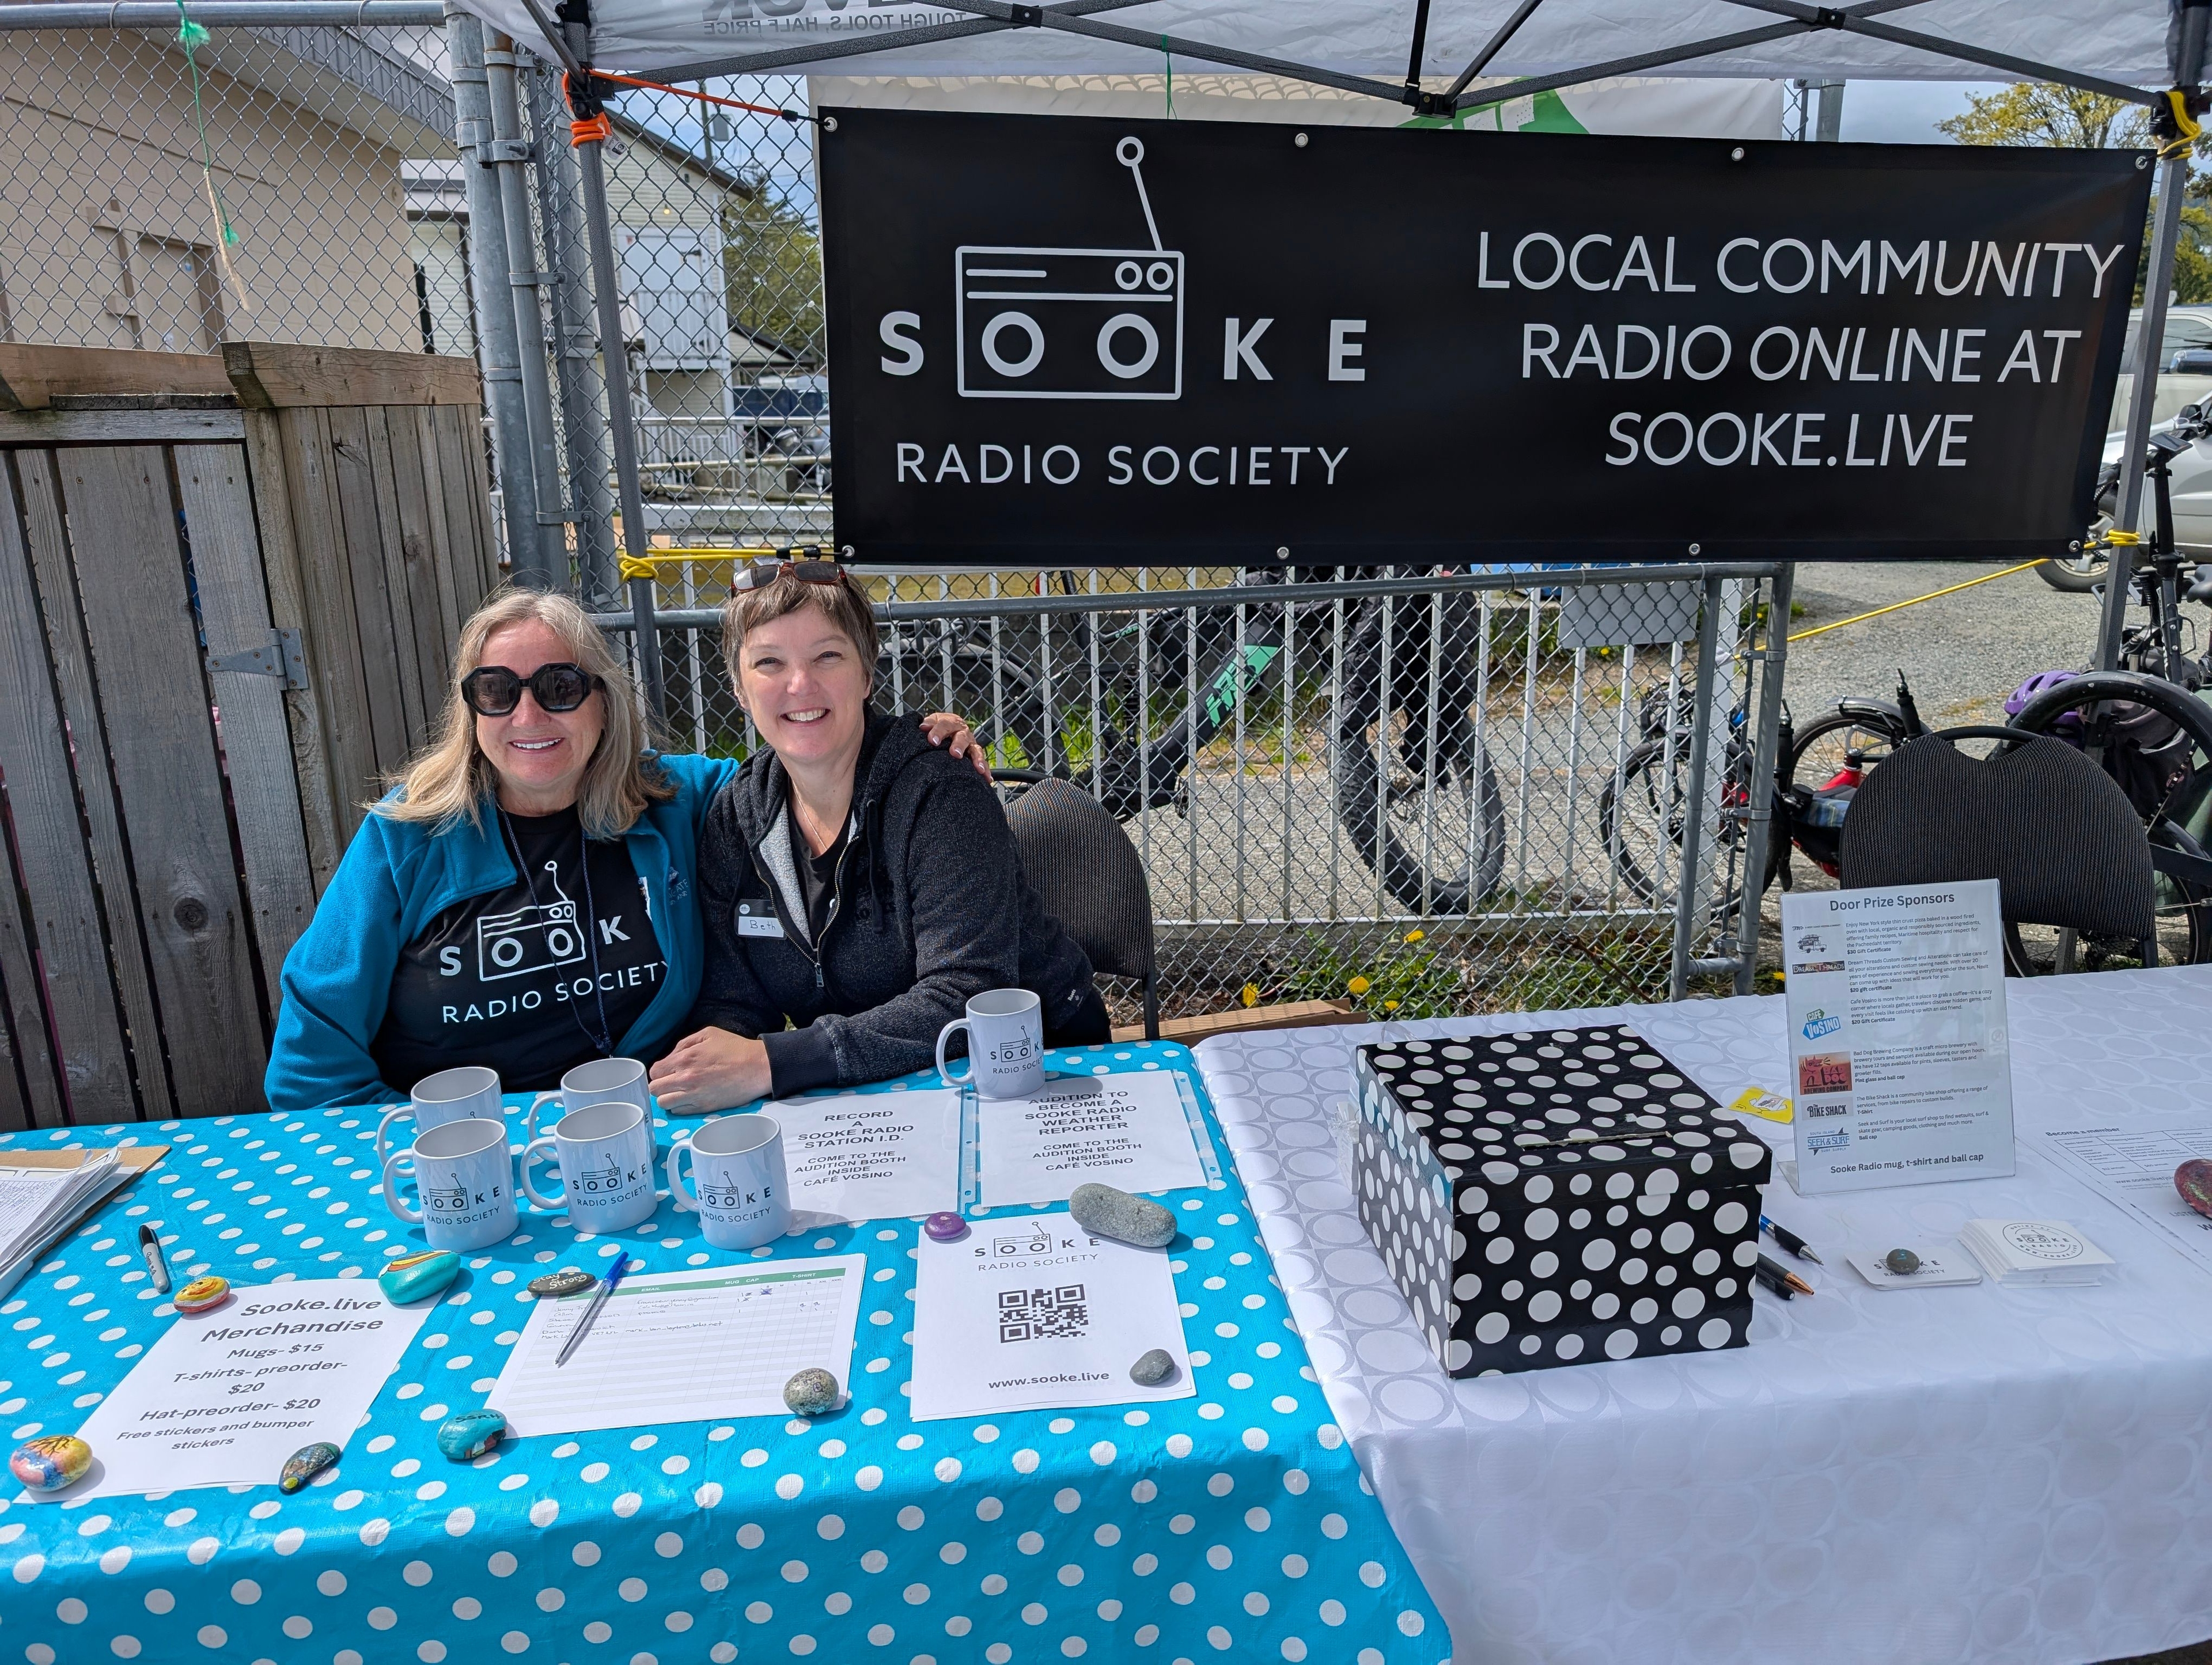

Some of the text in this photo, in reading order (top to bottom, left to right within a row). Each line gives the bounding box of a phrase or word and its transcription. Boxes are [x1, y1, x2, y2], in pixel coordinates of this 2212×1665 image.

[1478, 231, 2124, 298] LOCAL COMMUNITY
[1522, 324, 2081, 383] RADIO ONLINE AT
[1605, 412, 1974, 467] SOOKE.LIVE
[897, 443, 1349, 485] RADIO SOCIETY
[1830, 893, 1955, 911] Door Prize Sponsors
[749, 920, 776, 931] Beth
[440, 915, 631, 976] SOOK
[1067, 989, 1076, 1001] Roots
[442, 991, 541, 1023] RADIO
[1808, 1010, 1821, 1021] CAFE
[1022, 1057, 1043, 1071] SOCIET
[1826, 1085, 1849, 1093] COMPANY
[1028, 1094, 1102, 1104] AUDITION
[1039, 1100, 1106, 1110] BECOME
[825, 1111, 893, 1121] RECORD
[1025, 1106, 1137, 1120] SOOKE RADIO
[1807, 1105, 1847, 1117] BIKE SHACK
[1042, 1115, 1122, 1126] WEATHER
[798, 1125, 914, 1140] SOOKE RADIO
[1039, 1122, 1128, 1135] REPORTER
[805, 1136, 874, 1148] STATION
[1808, 1138, 1825, 1147] SEEK
[1832, 1136, 1849, 1144] SURF
[1032, 1144, 1142, 1158] AUDITION BOOTH
[1068, 1153, 1109, 1162] INSIDE
[794, 1156, 906, 1173] AUDITION BOOTH
[808, 1155, 846, 1163] COME
[1046, 1158, 1133, 1170] CAFÉ VOSINO
[1831, 1154, 1984, 1173] Sooke Radio mug, t-shirt and ball cap
[828, 1166, 870, 1175] INSIDE
[804, 1171, 893, 1186] CAFÉ VOSINO
[611, 1183, 647, 1204] SOCIETY
[427, 1206, 499, 1224] RADIO SOCIETY
[702, 1207, 771, 1222] RADIO SOCIETY
[979, 1254, 1098, 1271] RADIO SOCIETY
[1874, 1260, 1940, 1269] SKE
[550, 1273, 587, 1289] Strong
[240, 1298, 382, 1317] Sooke.live
[200, 1319, 384, 1342] Merchandise
[226, 1342, 324, 1360] Mugs- $15
[173, 1360, 348, 1383] T-shirts- preorder-
[988, 1371, 1110, 1389] www.sooke.live
[228, 1382, 265, 1395] $20
[139, 1398, 321, 1421] Hat-preorder- $20
[117, 1418, 315, 1440] Free stickers and bumper
[171, 1436, 235, 1450] stickers
